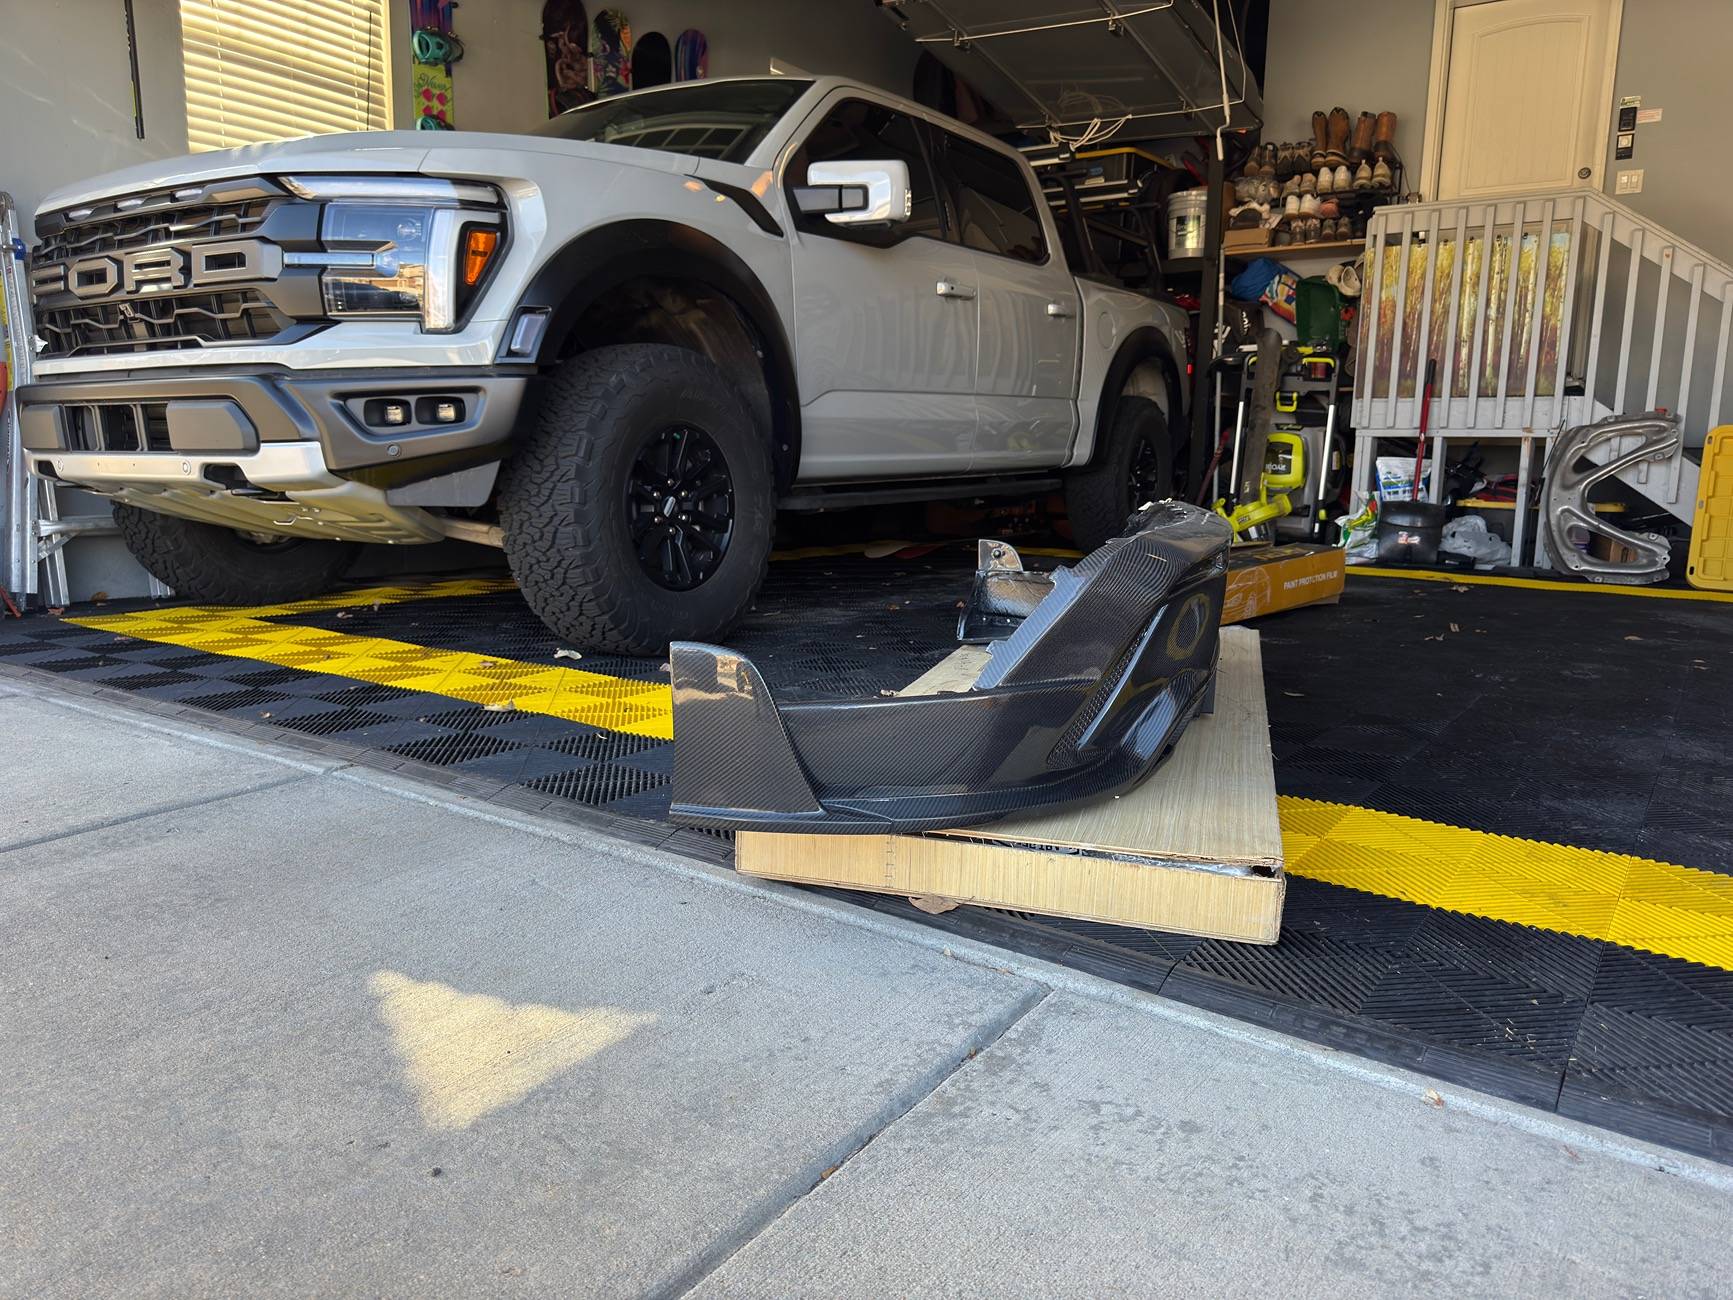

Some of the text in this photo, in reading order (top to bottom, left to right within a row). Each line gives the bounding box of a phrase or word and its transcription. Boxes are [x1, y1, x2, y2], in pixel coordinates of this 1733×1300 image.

[33, 240, 282, 302] FORD
[1284, 570, 1338, 590] PAINT PROTECTION FILM
